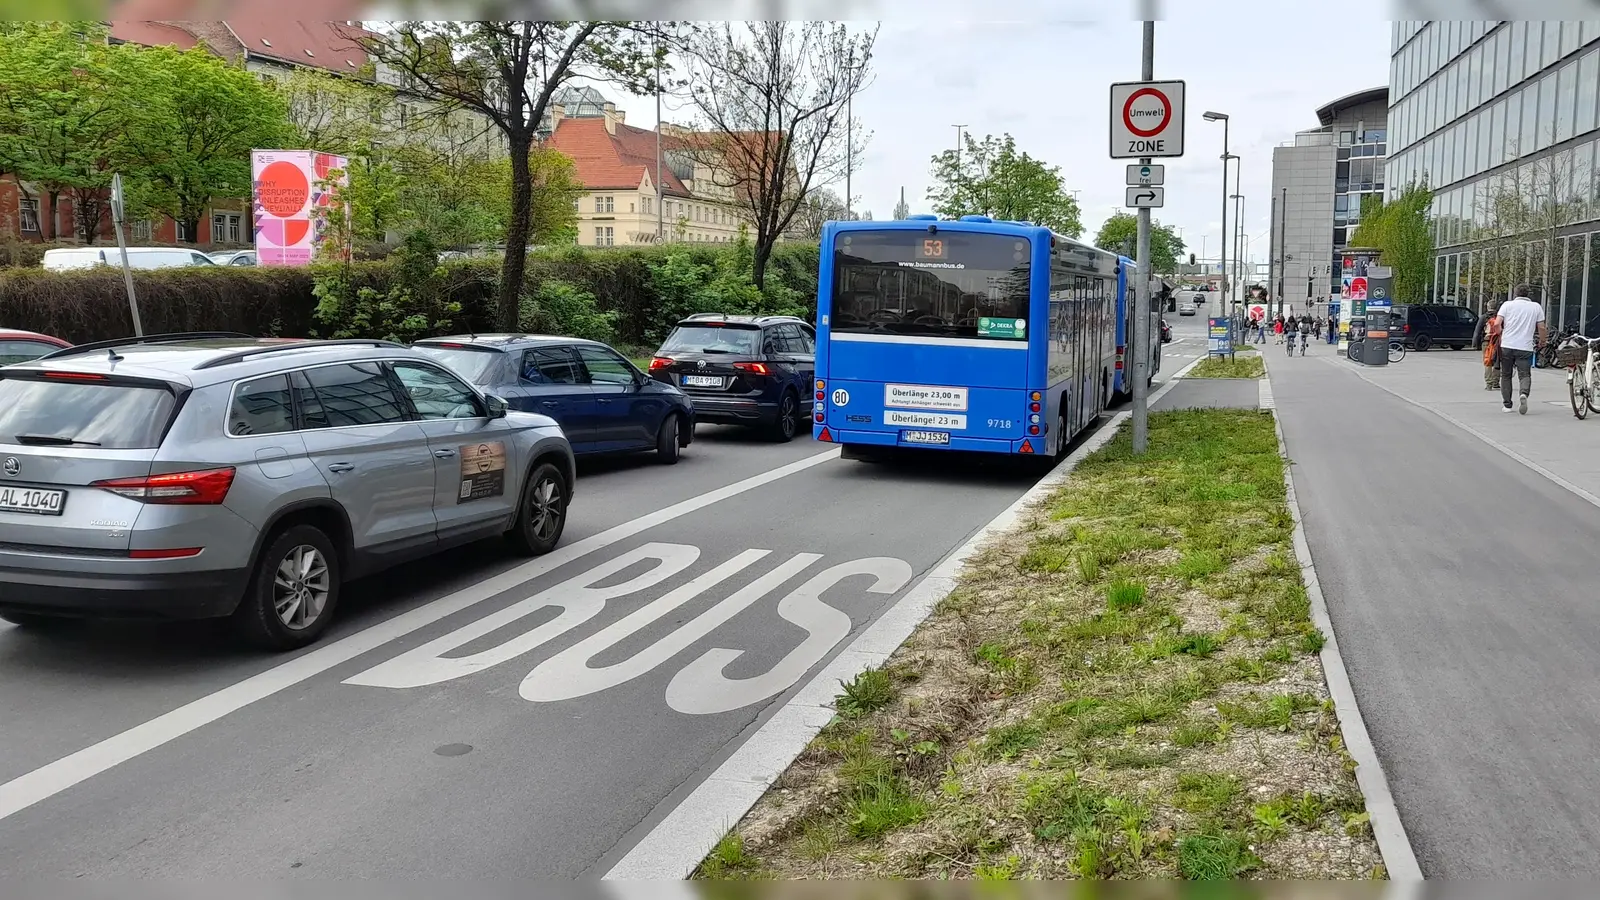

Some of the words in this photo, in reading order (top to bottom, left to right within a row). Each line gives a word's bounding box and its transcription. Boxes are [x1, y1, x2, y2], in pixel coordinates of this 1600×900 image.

[1129, 108, 1164, 117] Umwelt
[1128, 140, 1165, 152] ZONE
[259, 196, 304, 205] UNLEASHES
[924, 240, 942, 256] 53
[898, 261, 965, 270] www.baumannbus.de
[835, 391, 847, 404] 80
[892, 388, 929, 399] Überlänge
[931, 391, 952, 399] 23,00
[846, 414, 872, 423] HESS
[892, 413, 936, 425] Überlänge!
[938, 416, 949, 425] 23
[987, 418, 1011, 429] 9718
[0, 489, 18, 506] AL
[21, 490, 60, 509] 1040
[340, 542, 913, 715] BUS
